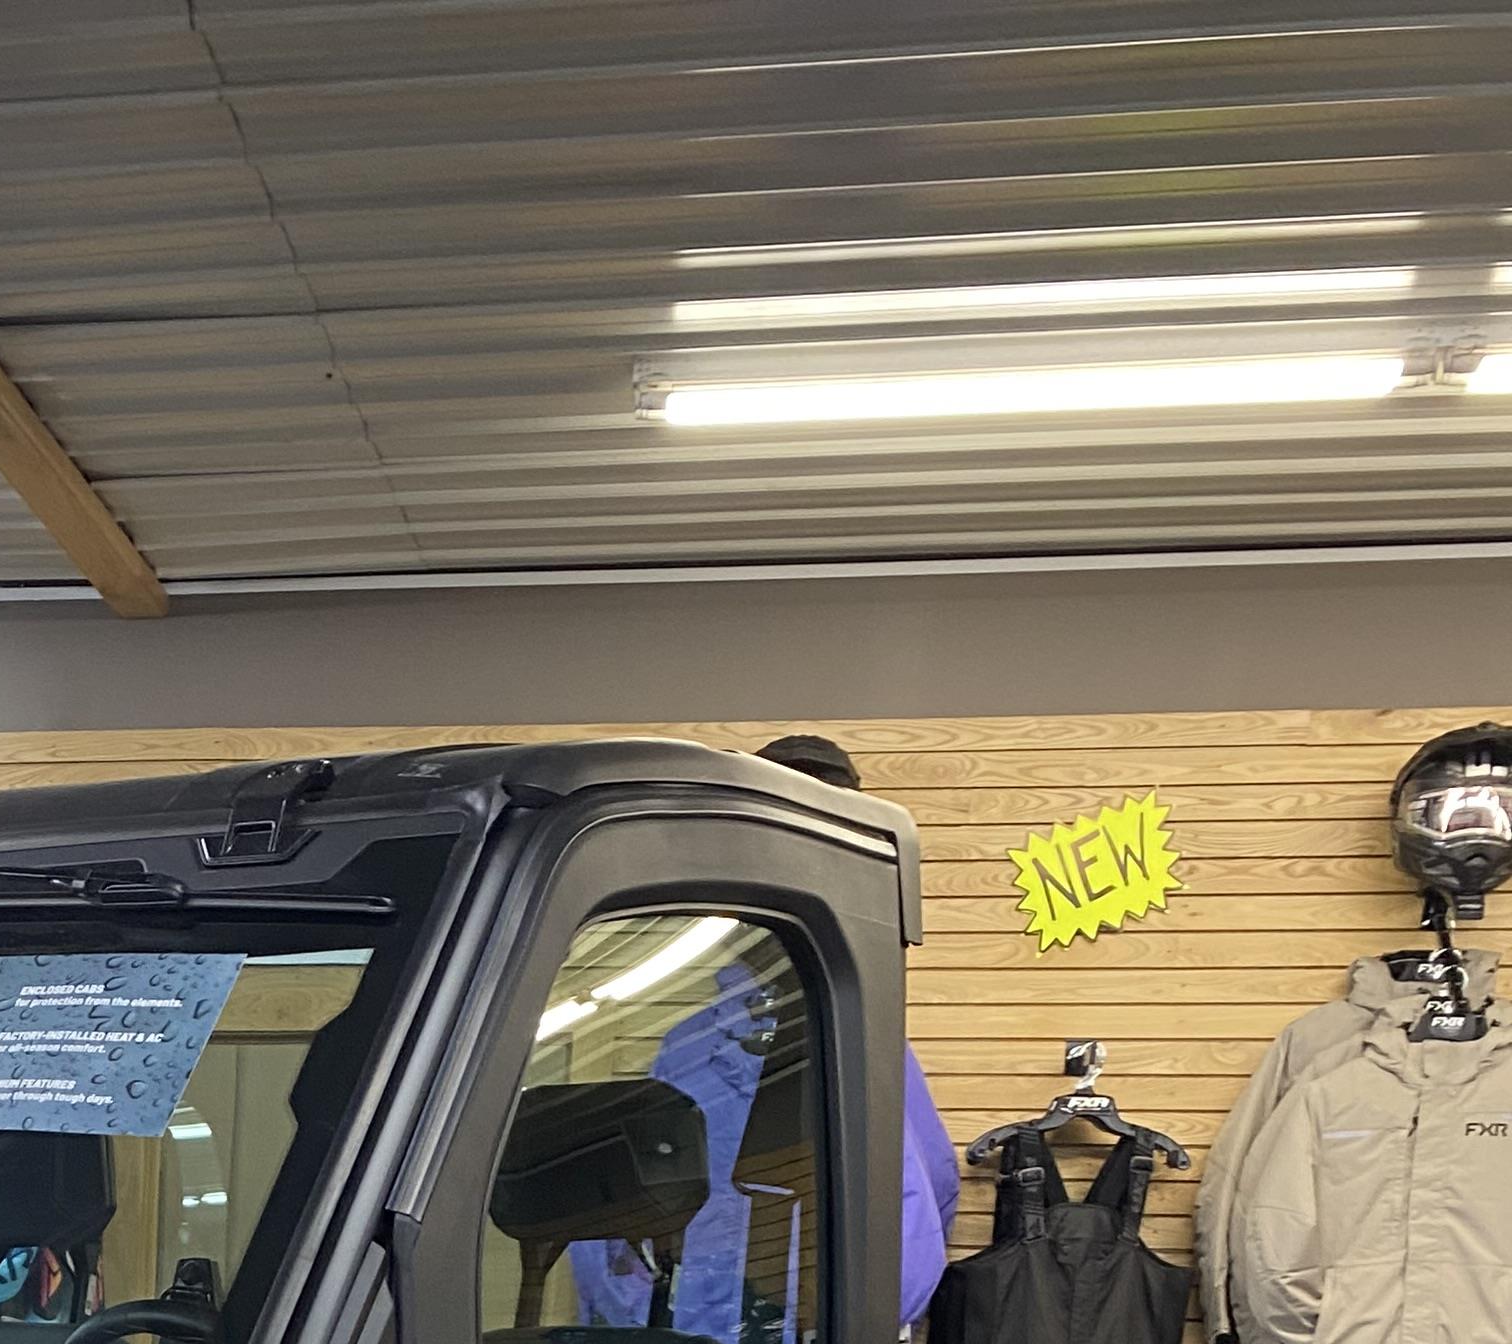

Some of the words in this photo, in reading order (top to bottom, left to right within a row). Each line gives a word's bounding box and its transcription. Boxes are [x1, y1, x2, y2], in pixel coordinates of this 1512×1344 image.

[1031, 812, 1150, 921] NEW
[20, 985, 75, 995] ENCLOSED
[75, 984, 106, 994] CABS
[15, 997, 31, 1006] for
[30, 996, 84, 1008] protection
[84, 996, 111, 1006] from
[111, 997, 130, 1006] the
[130, 997, 184, 1008] elements.
[1430, 1016, 1466, 1027] FXR
[105, 1032, 137, 1042] HEAT
[134, 1033, 145, 1043] &
[145, 1033, 165, 1043] AC
[8, 1043, 61, 1053] all-season
[61, 1044, 106, 1053] comfort.
[19, 1079, 77, 1090] FEATURES
[12, 1091, 54, 1103] through
[54, 1092, 86, 1105] tough
[85, 1093, 114, 1106] days.
[1068, 1096, 1110, 1108] FXR
[1464, 1122, 1509, 1137] FXR
